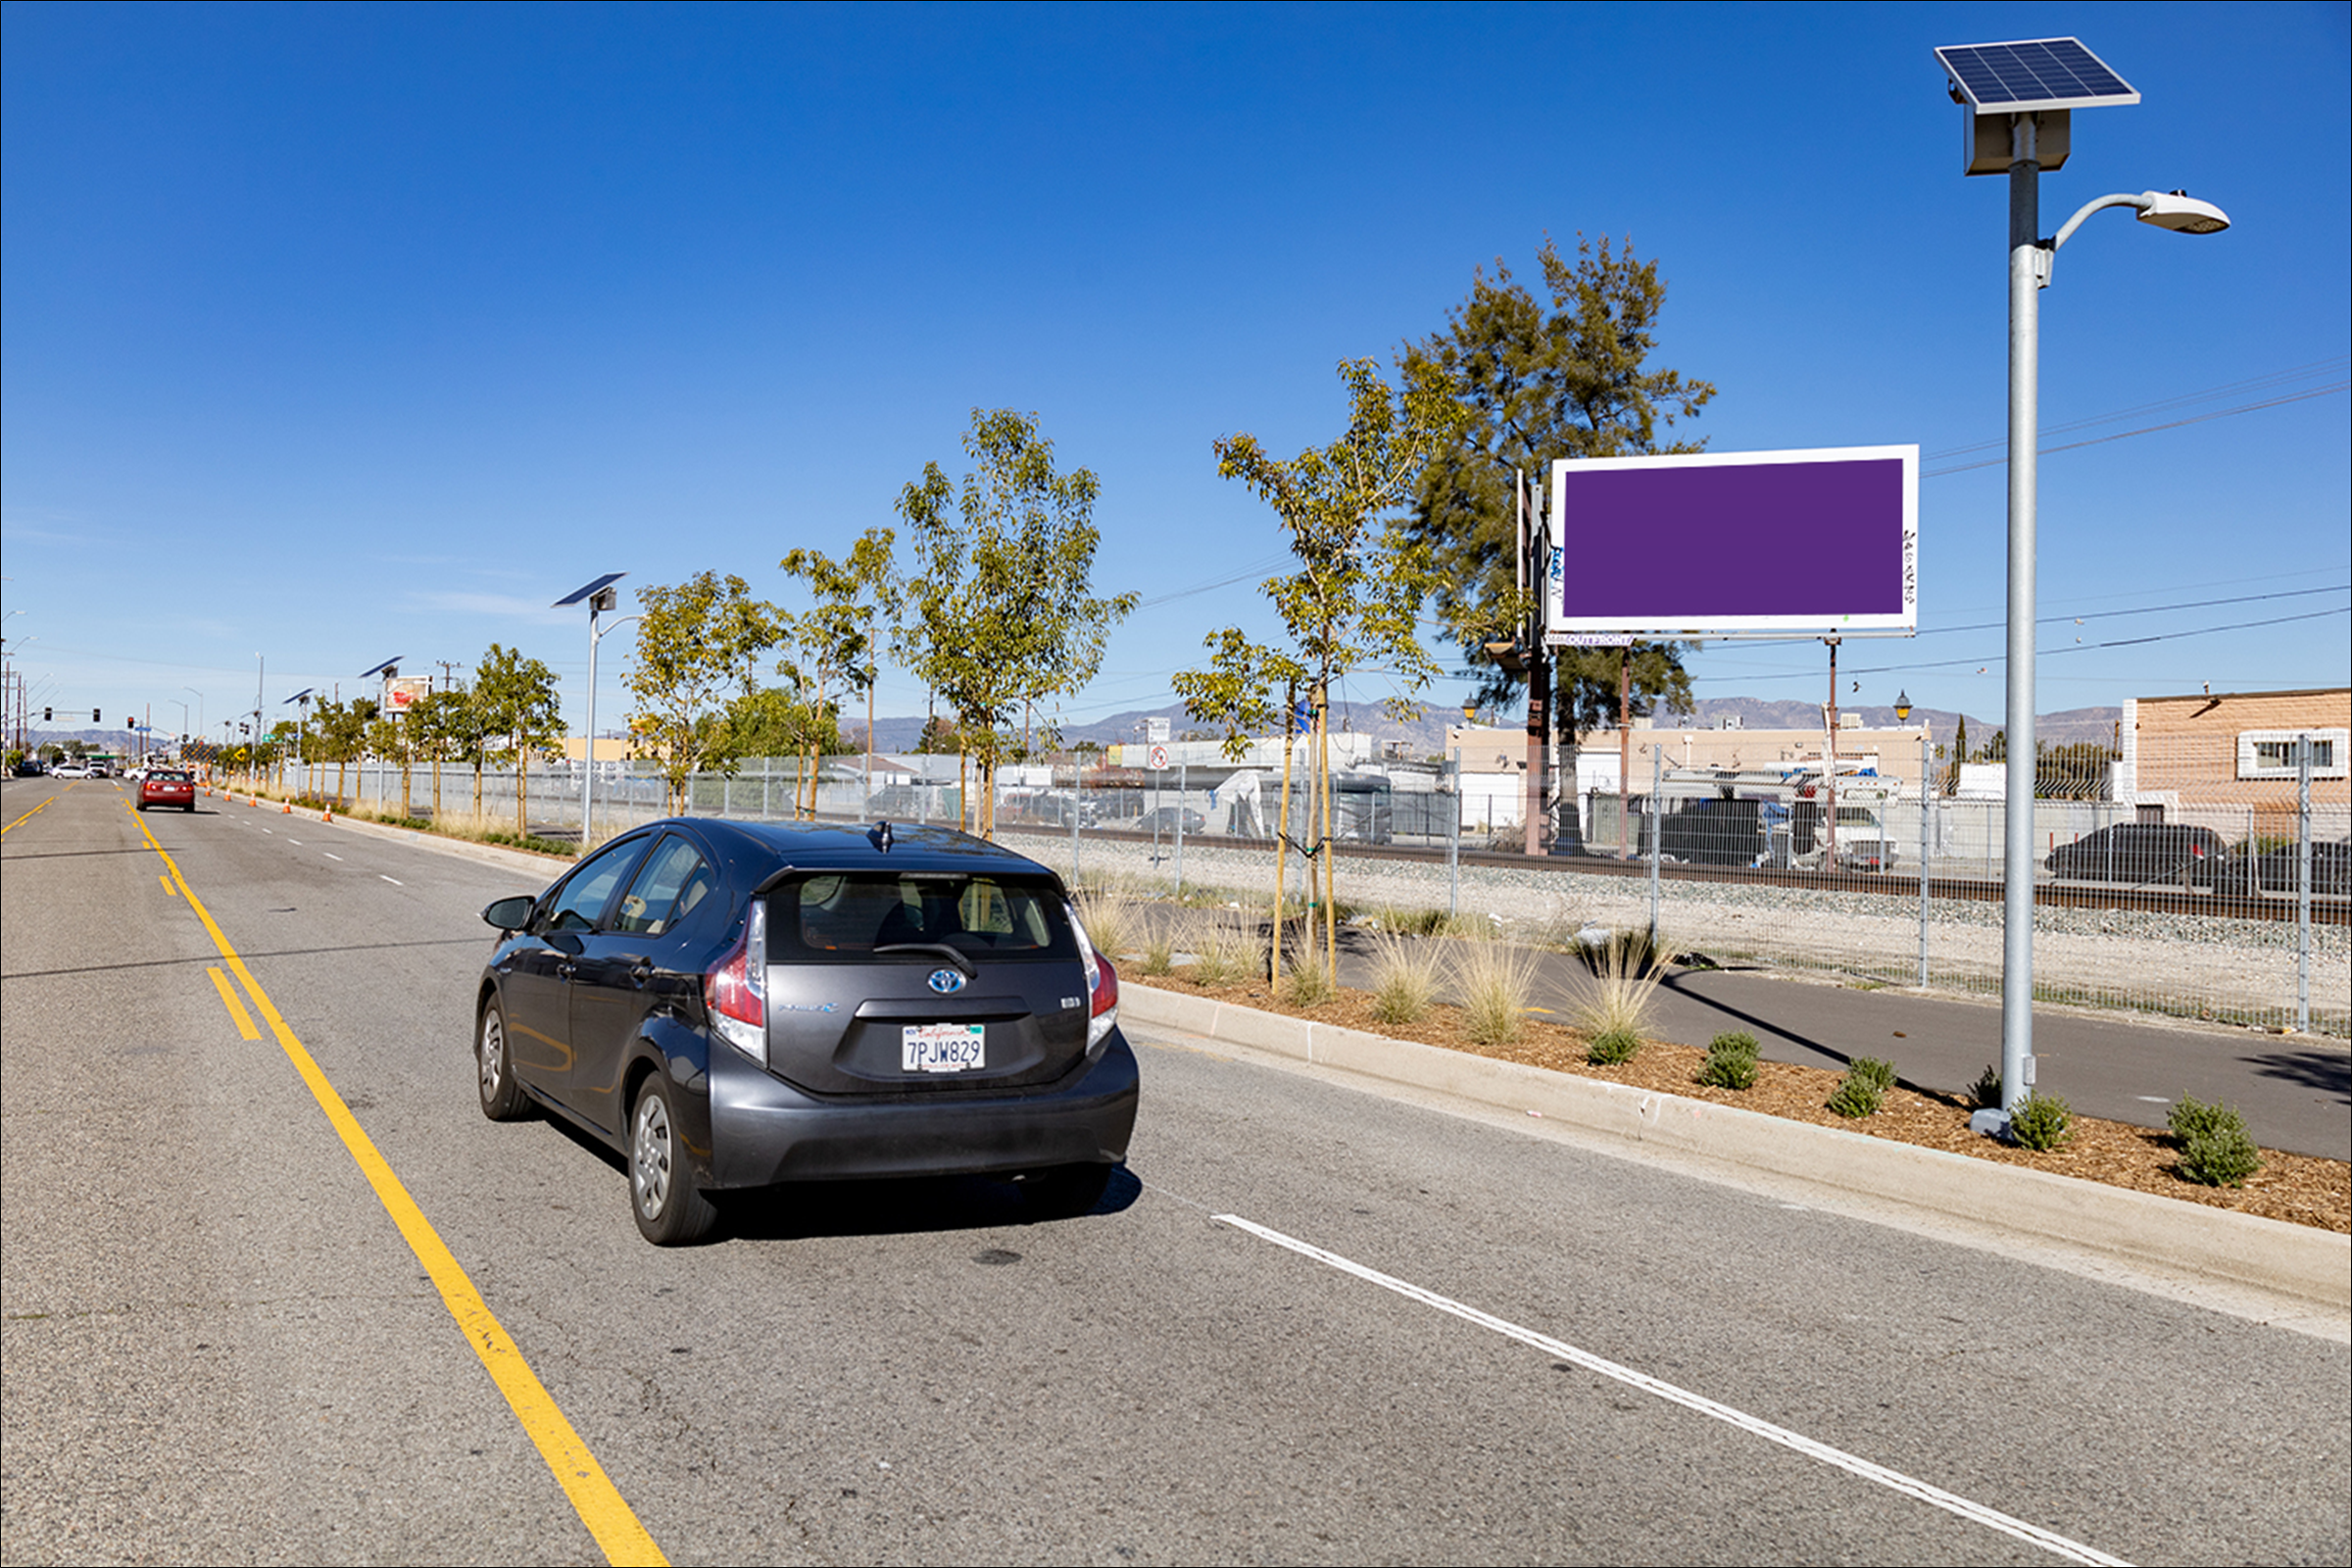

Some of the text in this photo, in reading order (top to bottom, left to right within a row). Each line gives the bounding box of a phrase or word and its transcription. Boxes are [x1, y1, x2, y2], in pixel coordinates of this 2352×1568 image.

[1569, 634, 1631, 646] OUTFRONT
[918, 1026, 969, 1040] California
[907, 1041, 980, 1063] 7PJW829
